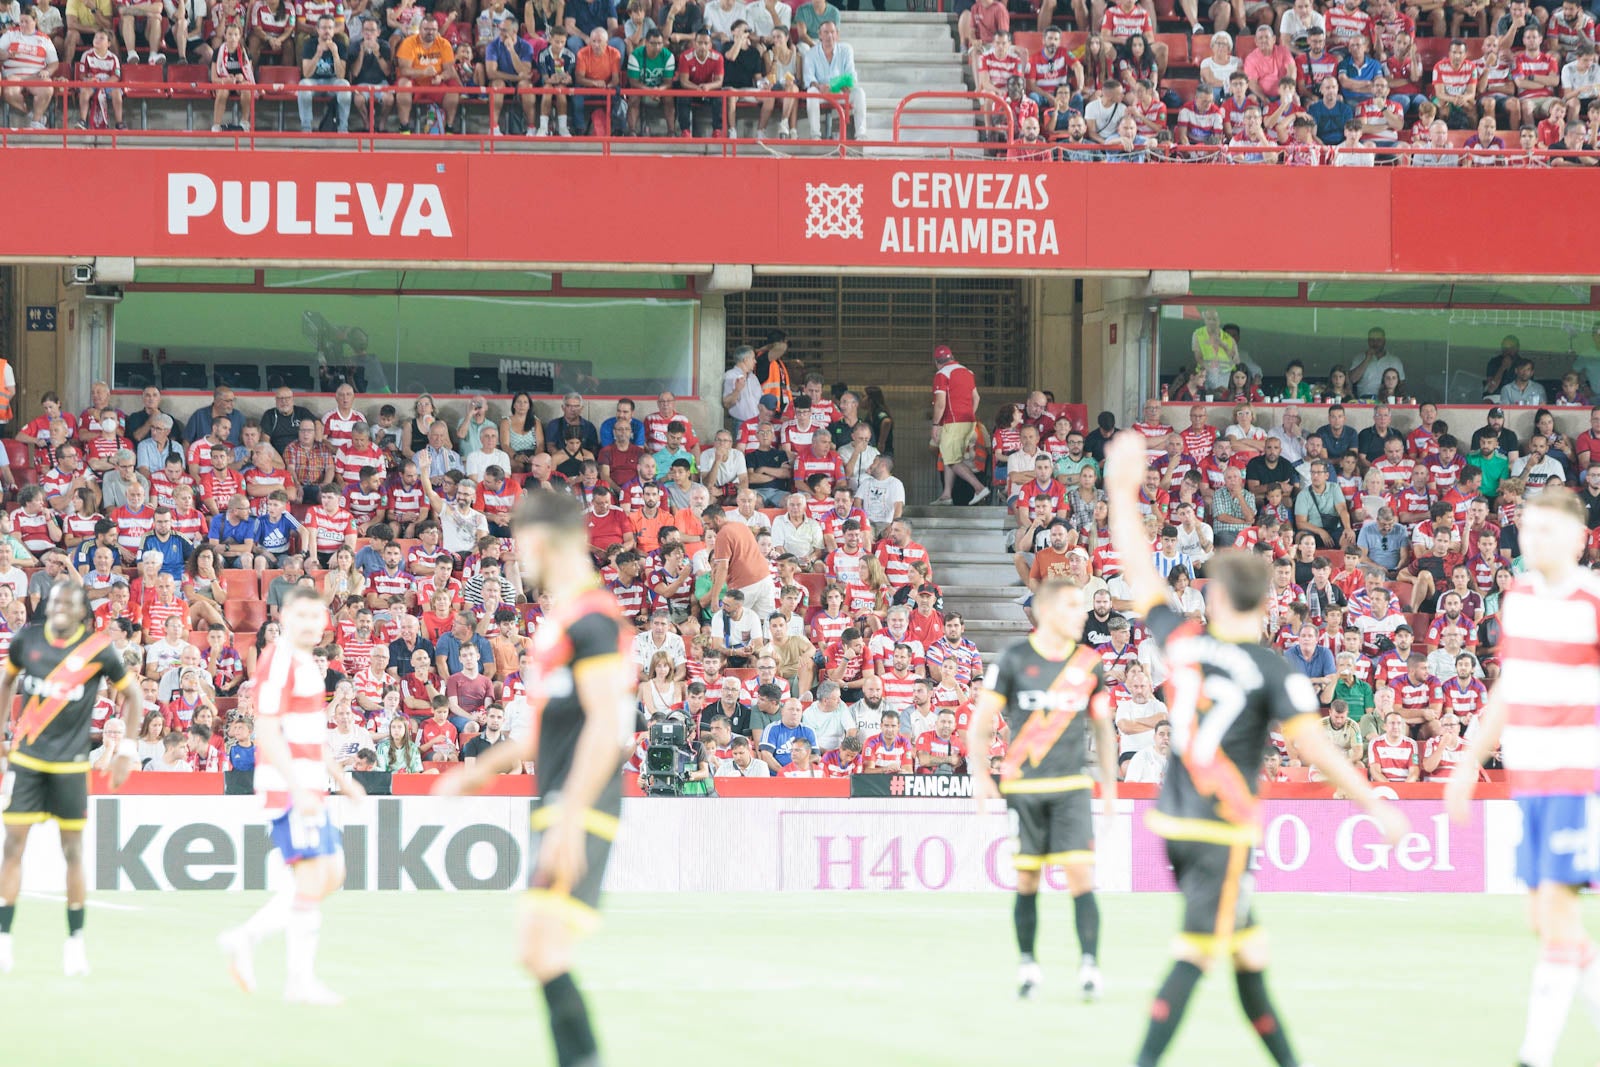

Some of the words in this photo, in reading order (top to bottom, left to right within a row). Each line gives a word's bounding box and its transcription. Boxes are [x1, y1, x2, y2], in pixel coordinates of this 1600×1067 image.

[167, 172, 453, 237] PULEVA
[891, 171, 1050, 210] CERVEZAS
[879, 216, 1060, 255] ALHAMBRA
[317, 527, 344, 541] Platzi
[1169, 666, 1247, 767] 17
[889, 775, 975, 797] #FANCAM
[813, 835, 955, 890] H40
[1335, 813, 1456, 873] Gel
